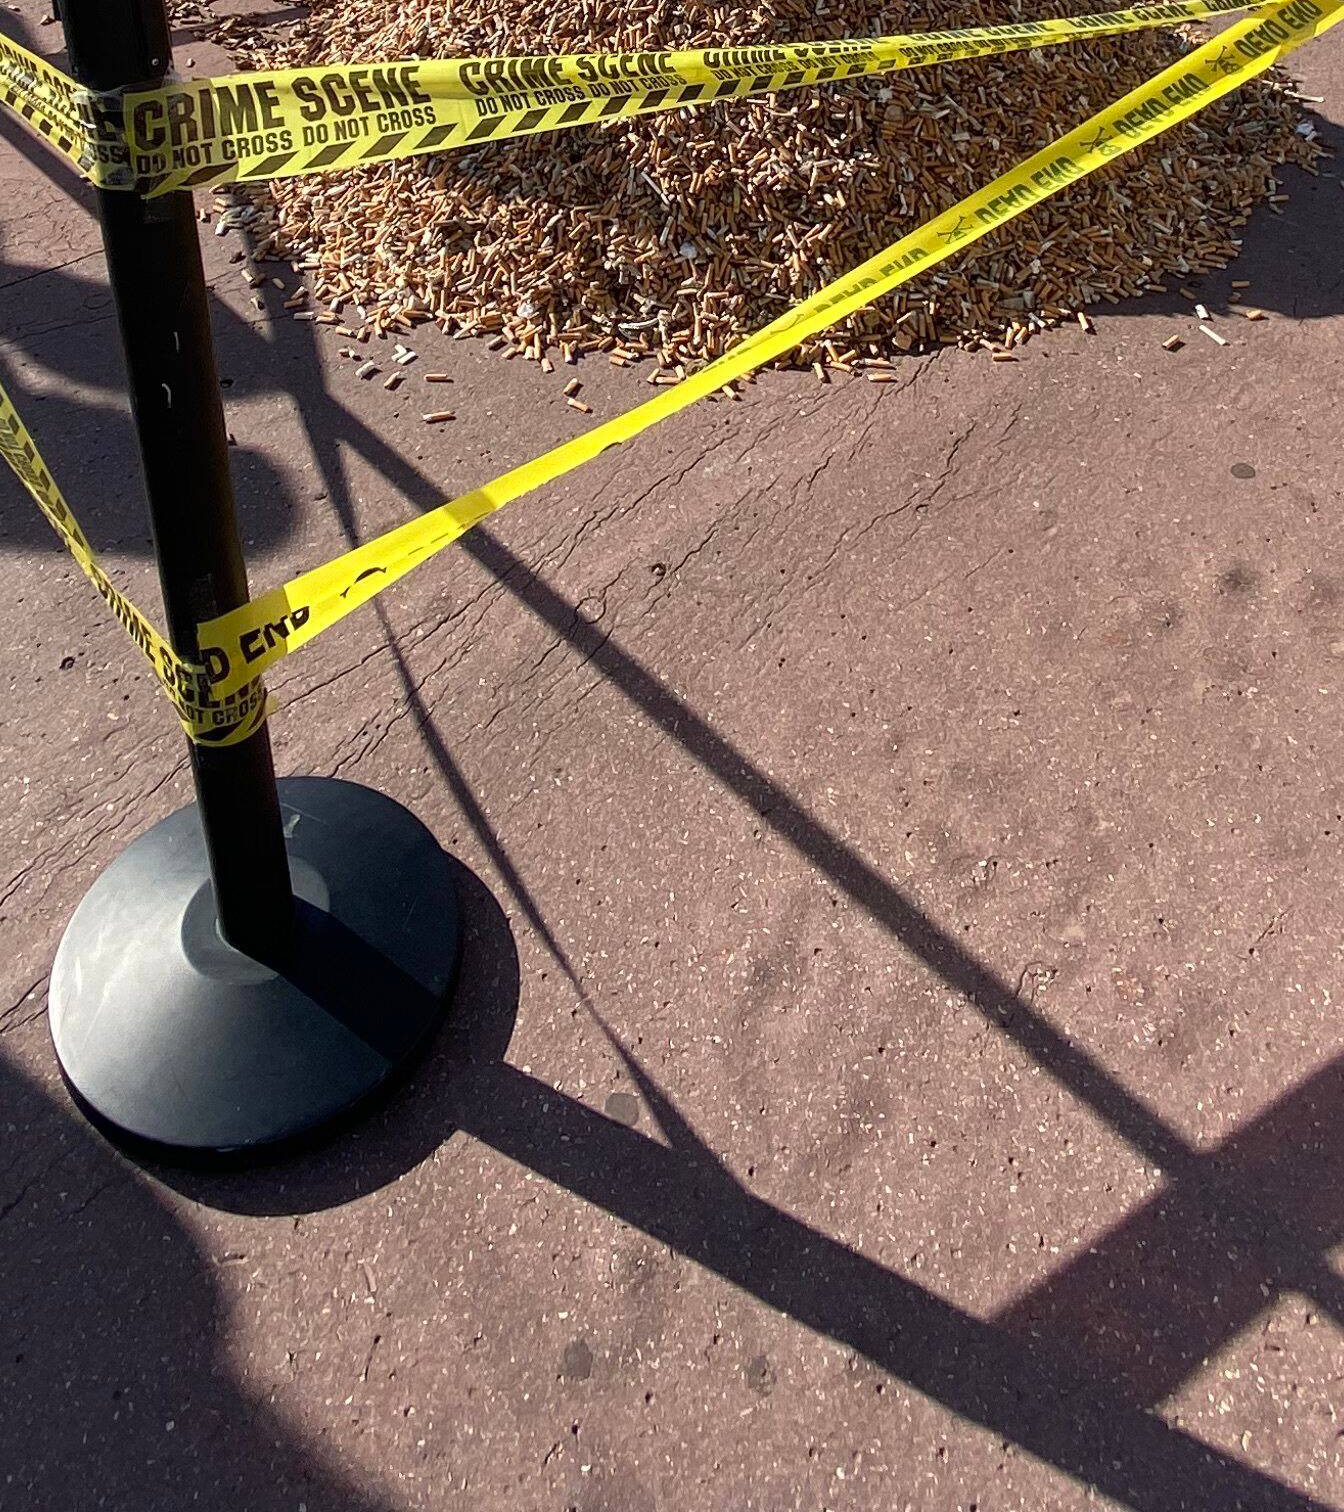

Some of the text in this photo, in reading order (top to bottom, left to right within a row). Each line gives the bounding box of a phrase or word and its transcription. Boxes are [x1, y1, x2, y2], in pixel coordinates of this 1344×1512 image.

[459, 57, 574, 96] CRIME
[475, 97, 494, 117] DO
[499, 92, 531, 113] NOT
[533, 86, 586, 106] CROSS
[587, 82, 611, 98] DO
[610, 79, 640, 95] NOT
[135, 80, 285, 150] CRIME
[291, 66, 432, 120] SCENE
[140, 106, 436, 175] DO NOT CROSS DO NOT CROSS
[239, 605, 310, 664] END
